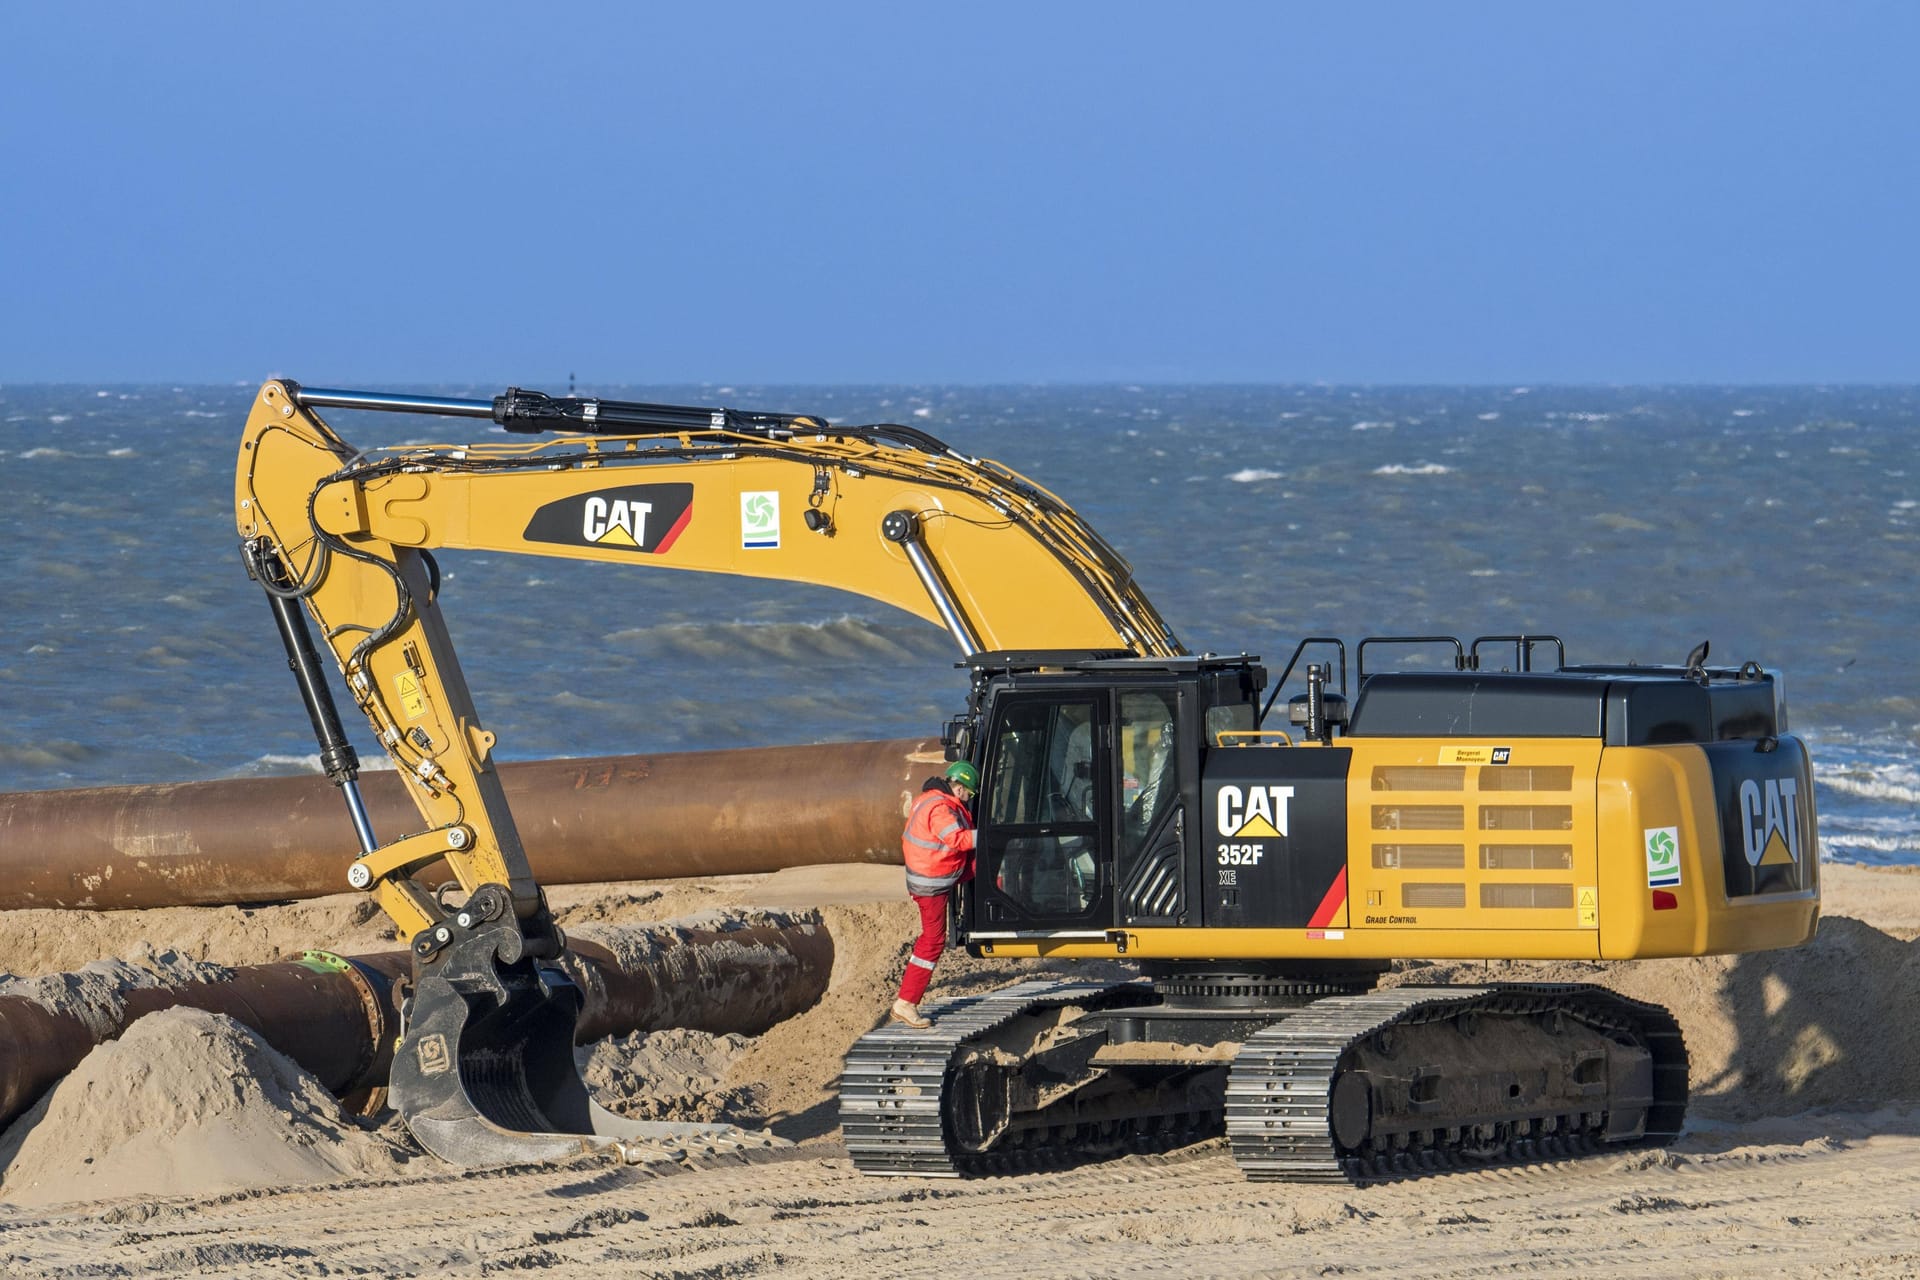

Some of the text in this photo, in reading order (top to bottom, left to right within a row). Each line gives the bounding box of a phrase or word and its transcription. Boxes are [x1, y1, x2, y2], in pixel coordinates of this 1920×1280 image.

[583, 496, 653, 547] CAT
[1493, 751, 1509, 761] CAT
[1217, 785, 1295, 838] CAT
[1739, 777, 1798, 866] CAT
[1217, 844, 1264, 865] 352F
[1218, 870, 1237, 885] XE
